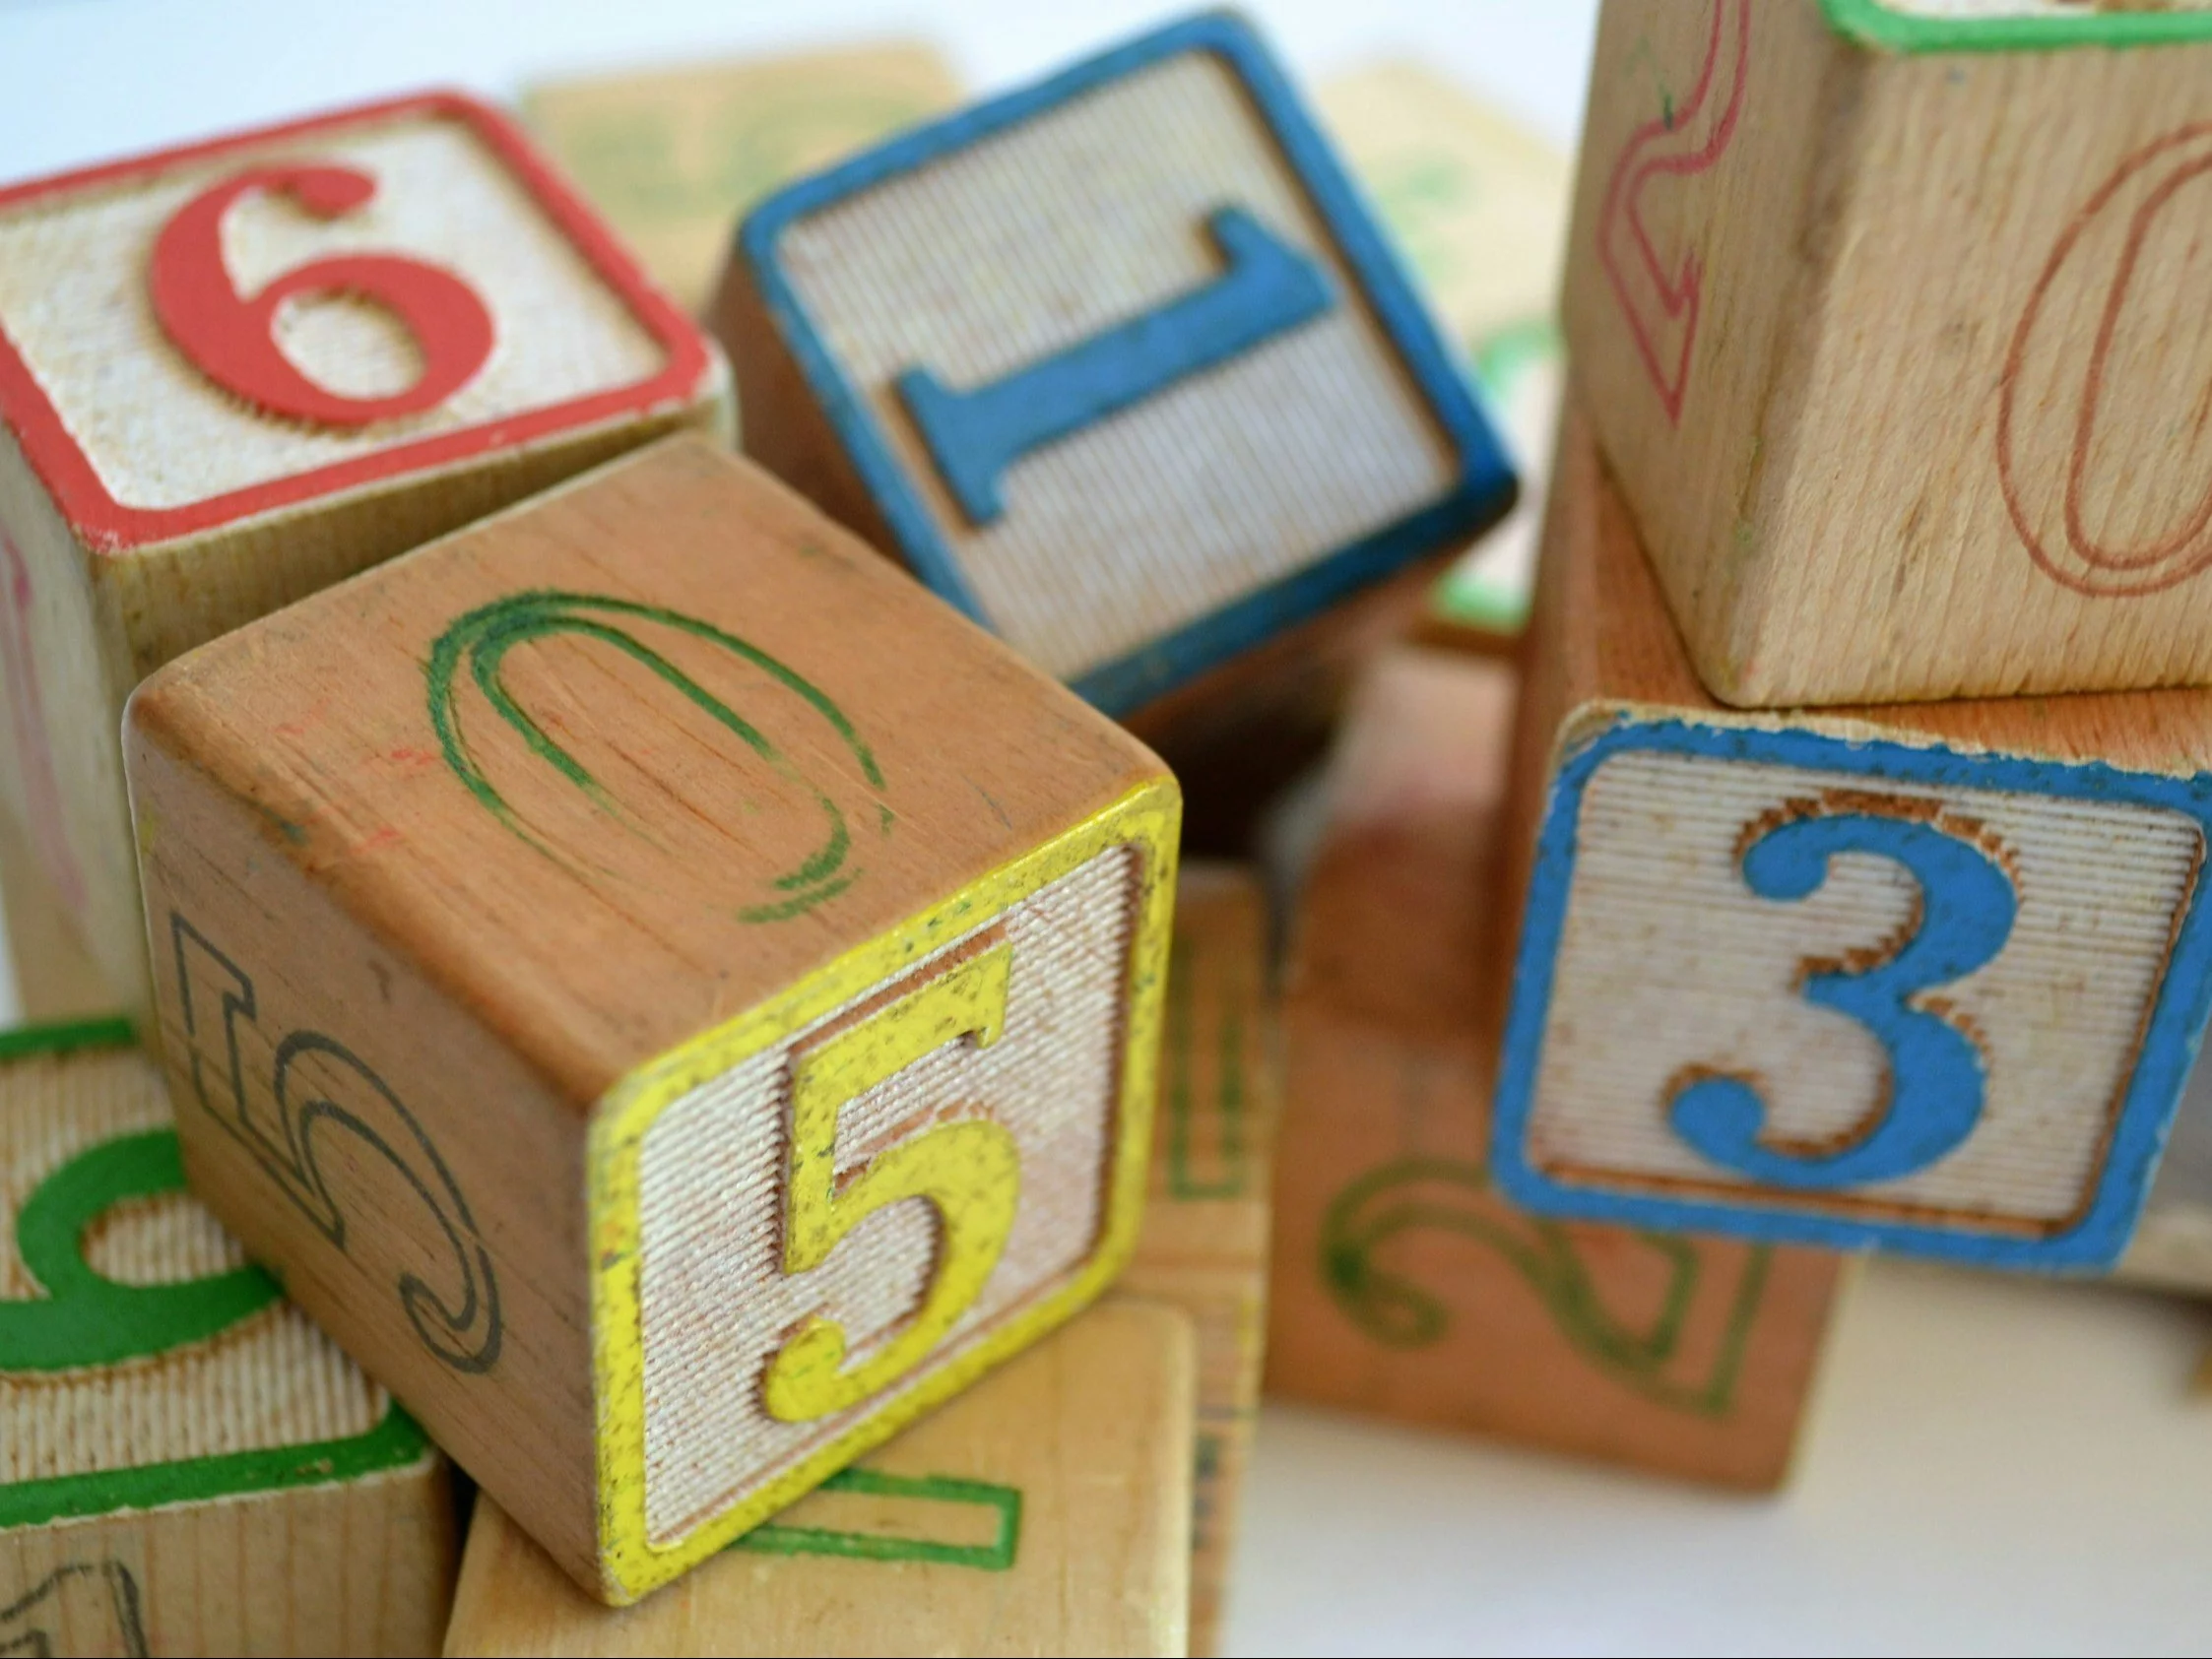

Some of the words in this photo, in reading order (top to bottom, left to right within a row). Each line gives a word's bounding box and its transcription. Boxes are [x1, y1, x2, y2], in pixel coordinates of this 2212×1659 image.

[151, 164, 494, 427] 6
[898, 205, 1337, 527] 1
[170, 909, 503, 1373] 5
[764, 941, 1021, 1423] 5
[1669, 812, 2018, 1187] 3
